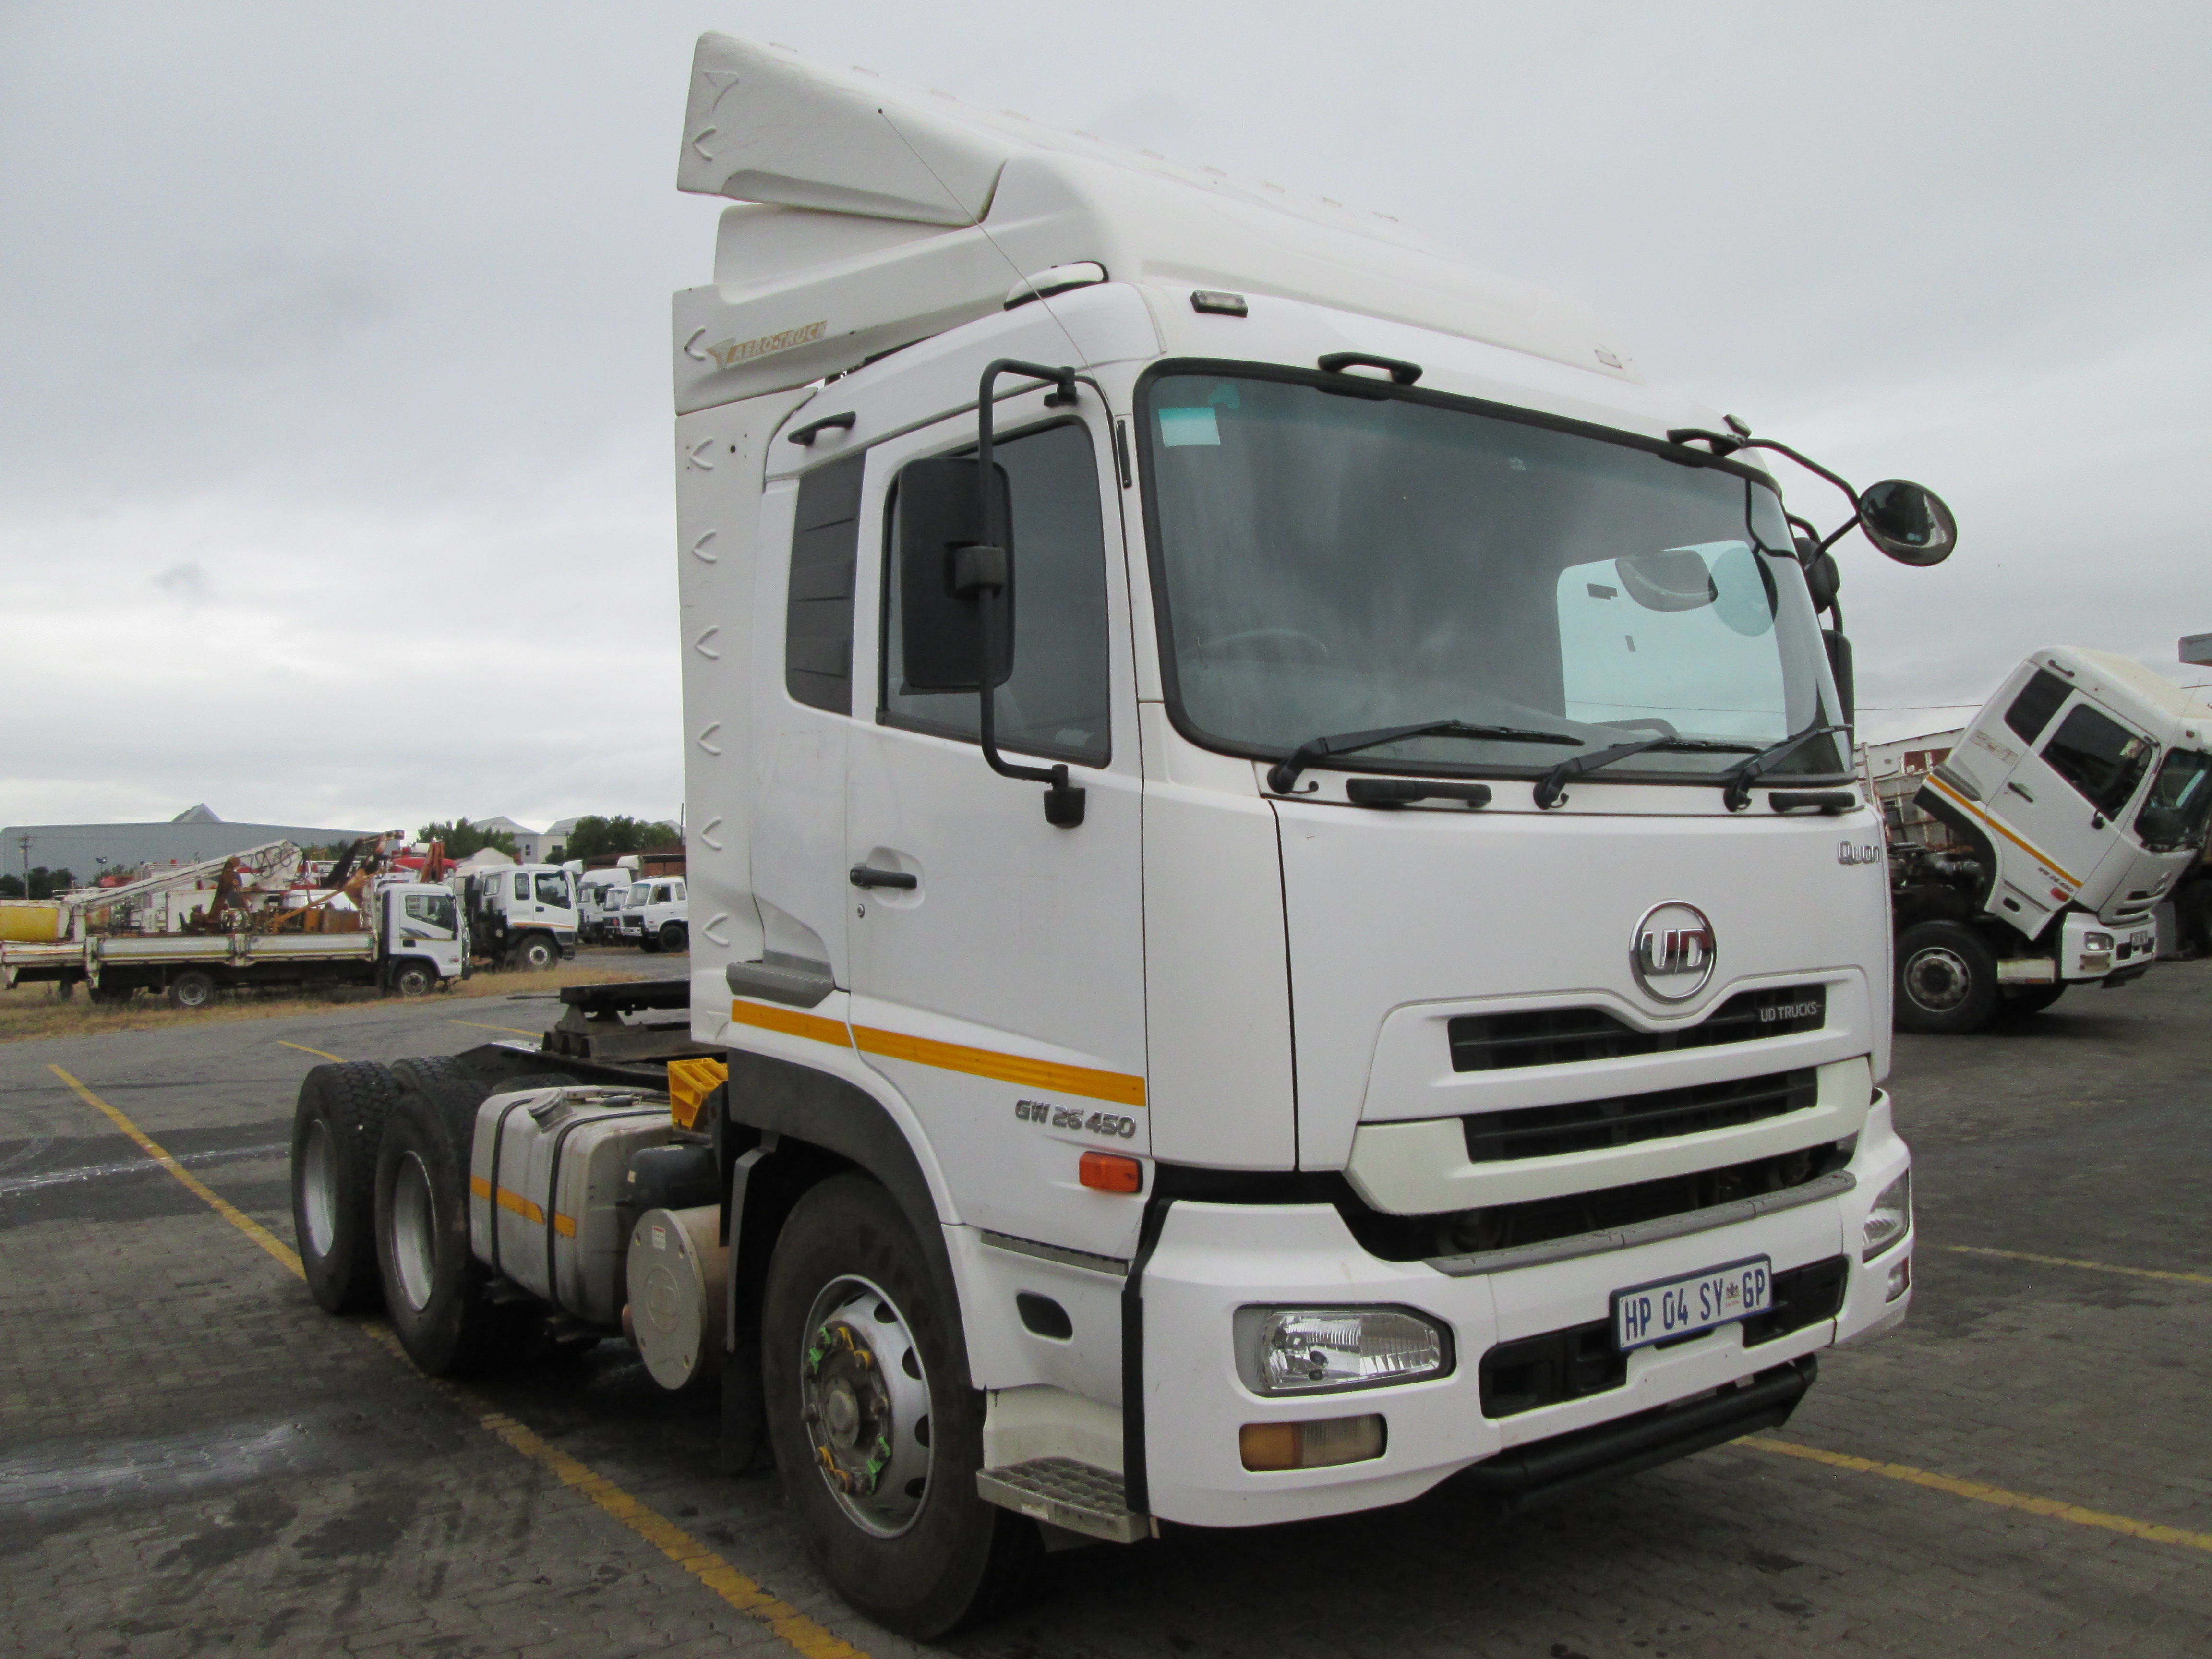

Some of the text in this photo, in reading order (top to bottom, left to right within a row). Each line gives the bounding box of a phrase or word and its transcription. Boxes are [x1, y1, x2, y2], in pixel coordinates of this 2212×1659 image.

[1640, 928, 1714, 976] UD
[1760, 1001, 1818, 1022] UD TRUCKS
[1015, 1098, 1136, 1139] GW 26 450
[1624, 1268, 1766, 1341] HP 04 SY GP
